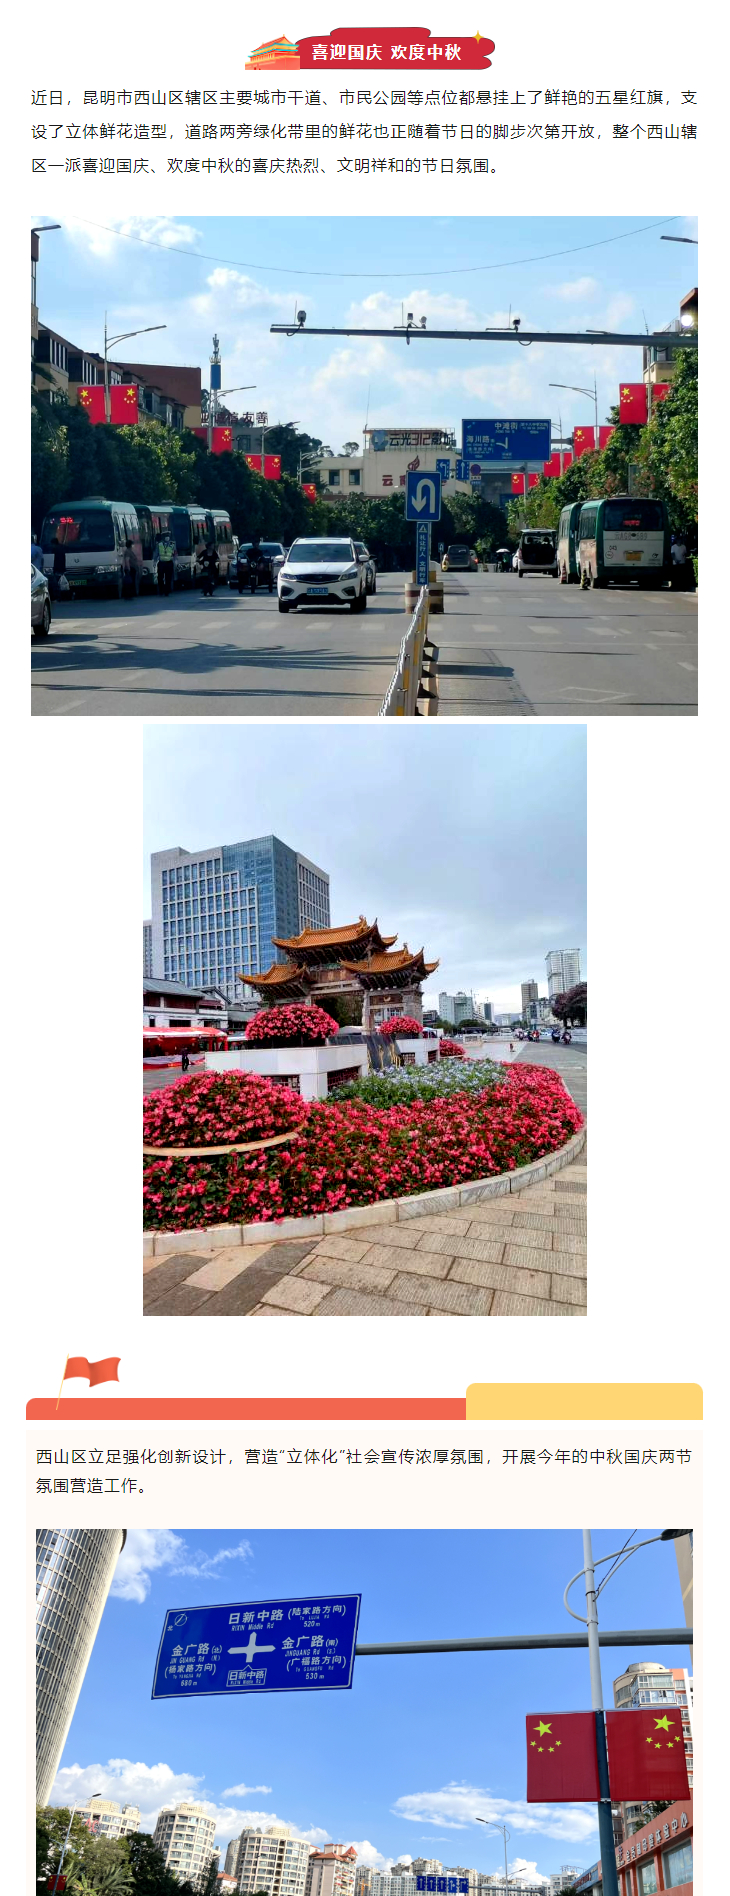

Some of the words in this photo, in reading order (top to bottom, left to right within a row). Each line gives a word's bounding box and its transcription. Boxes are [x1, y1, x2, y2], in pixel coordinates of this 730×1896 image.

[311, 43, 382, 61] 喜迎国庆
[390, 43, 461, 61] 欢度中秋
[31, 89, 698, 106] 近日，昆明市西山区辖区主要城市干道、市民公园等点位都悬挂上了鲜艳的五星红旗，支
[31, 123, 698, 140] 设了立体鲜花造型，道路两旁绿化带里的鲜花也正随着节日的脚步次第开放，整个西山辖
[31, 157, 497, 174] 区一派喜迎国庆、欢度中秋的喜庆热烈、文明祥和的节日氛围。
[36, 1478, 145, 1494] 氛围营造工作。
[228, 1608, 284, 1625] 日新中路
[229, 1670, 265, 1680] 日新中路
